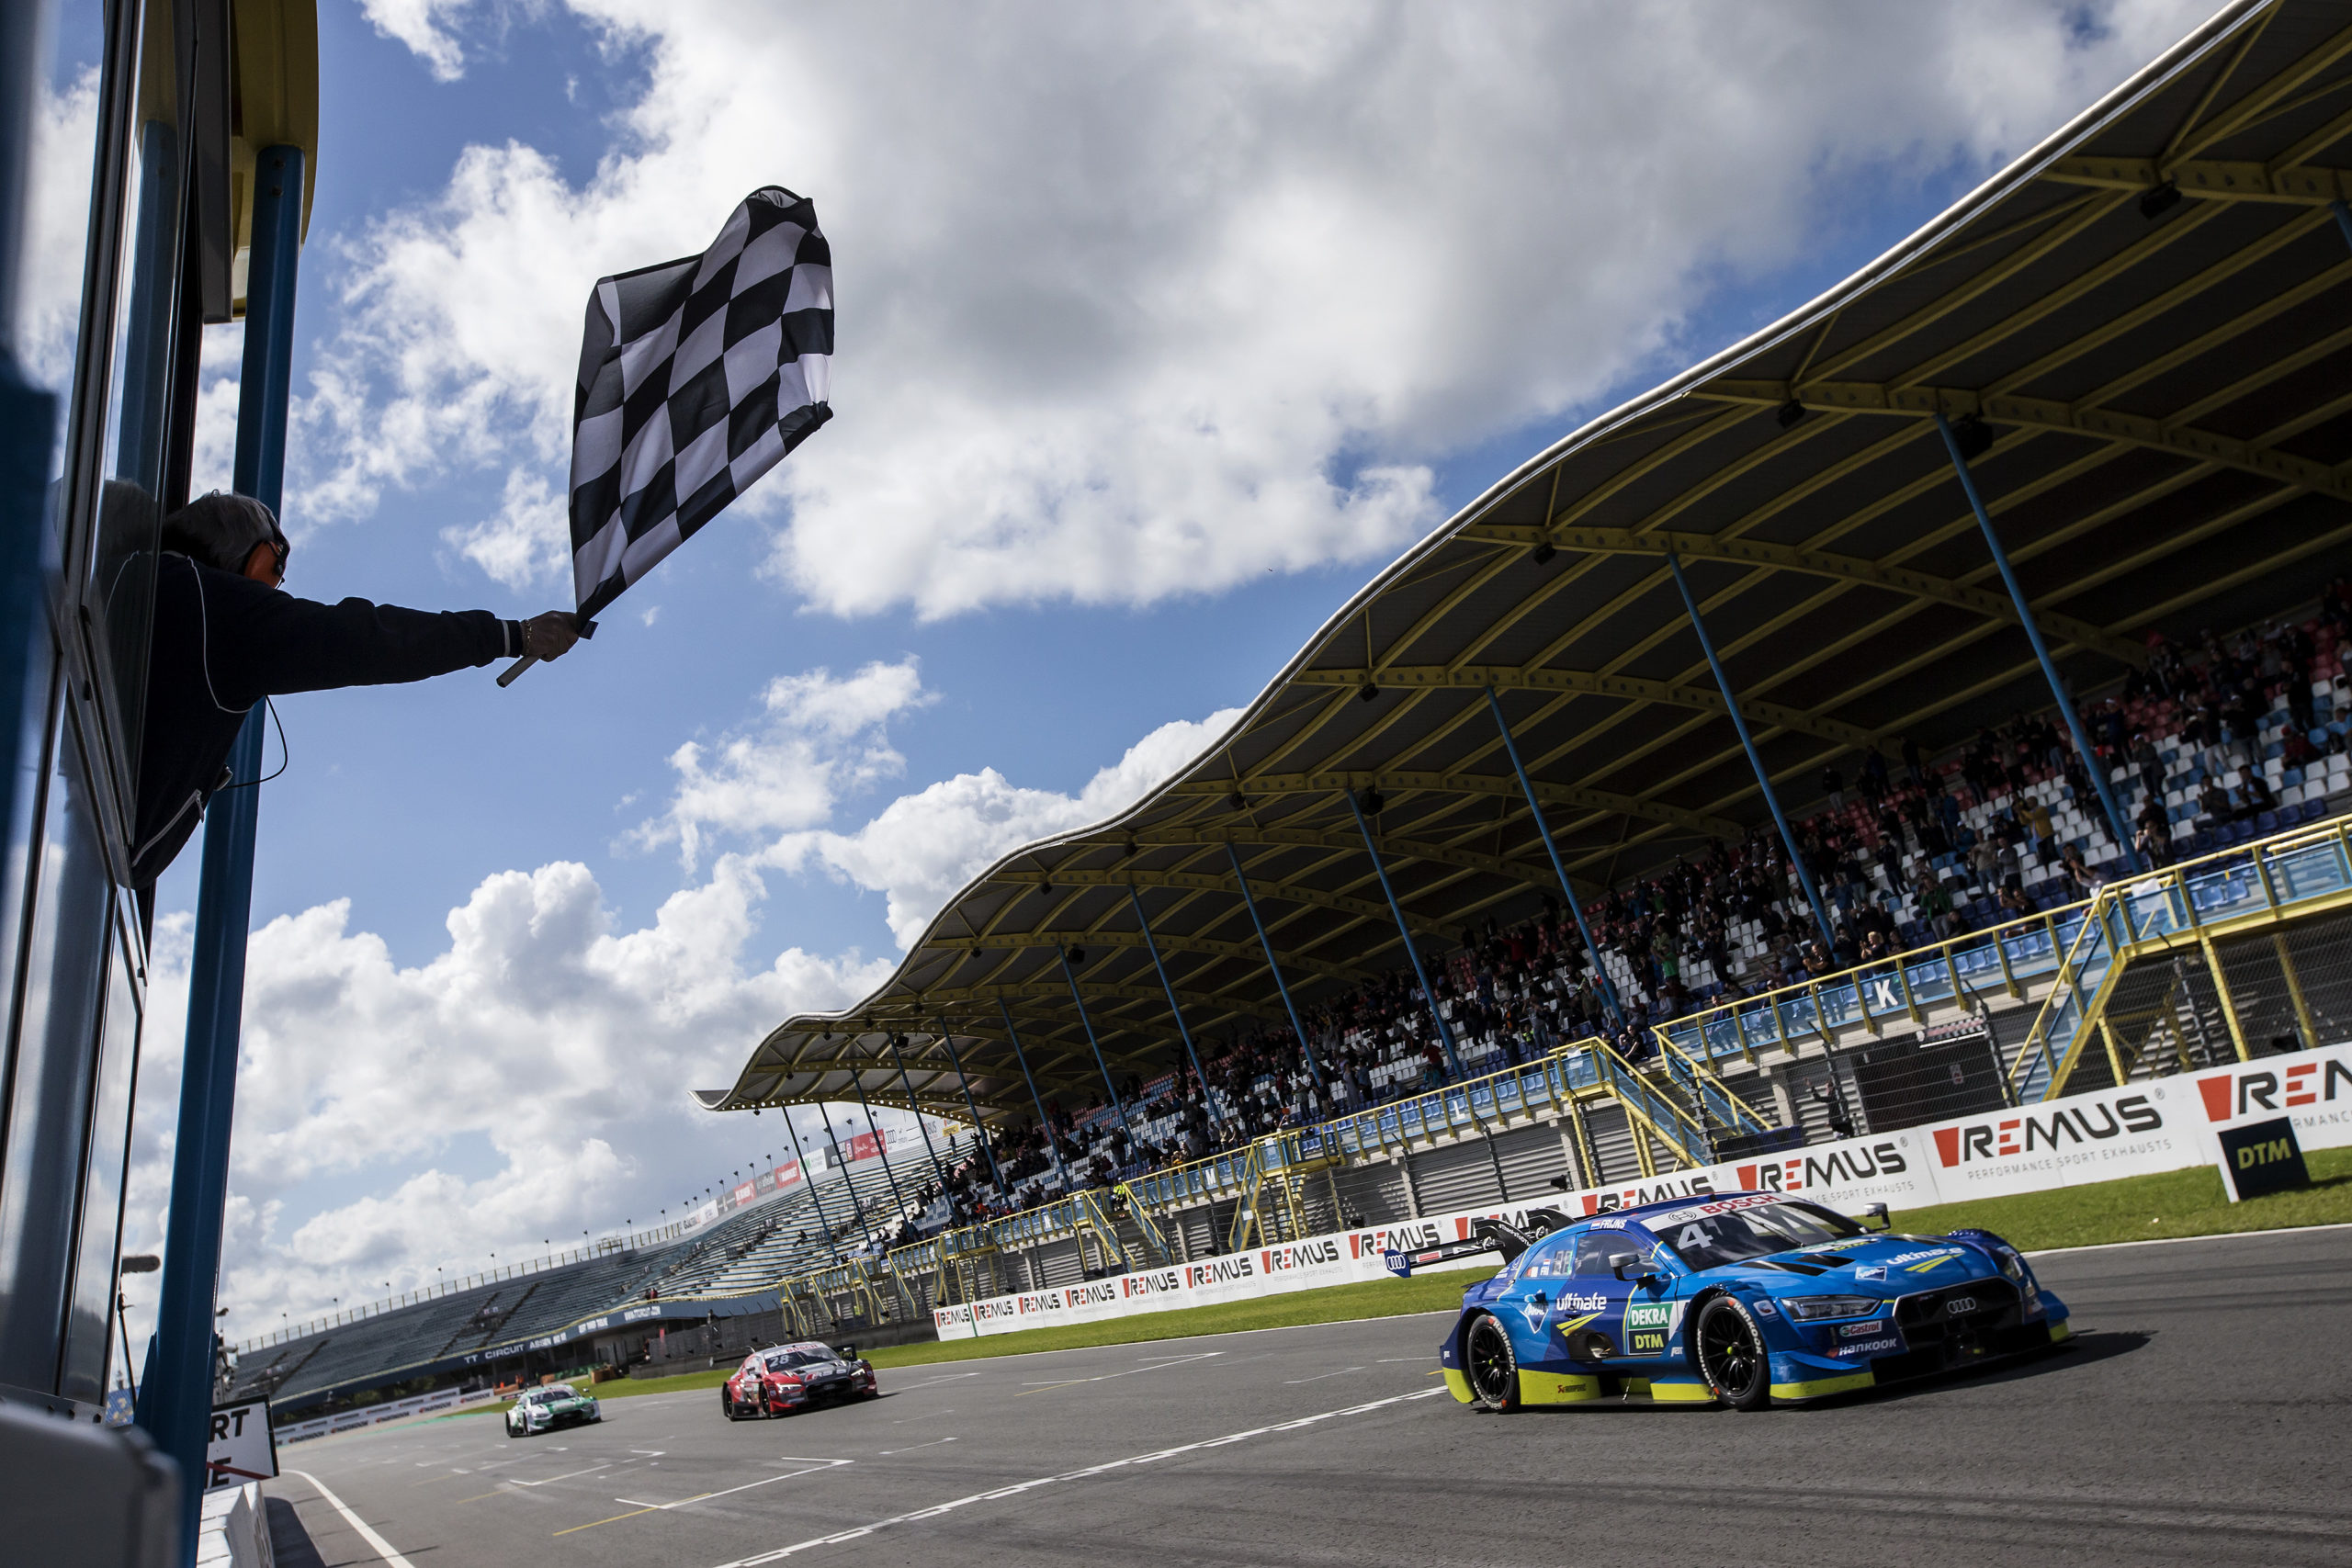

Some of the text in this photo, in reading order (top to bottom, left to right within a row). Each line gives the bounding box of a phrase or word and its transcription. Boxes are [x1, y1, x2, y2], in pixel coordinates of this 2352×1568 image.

[1874, 978, 1898, 1010] K
[1453, 1100, 1465, 1120] L
[1964, 1095, 2163, 1162] REMUS
[1968, 1138, 2172, 1181] PERFORMANCE SPORT EXHAUSTS
[2236, 1137, 2292, 1170] DTM
[1761, 1142, 1906, 1192] REMUS
[1827, 1189, 1860, 1202] SPORT
[1864, 1180, 1915, 1197] EXHAUSTS
[1700, 1194, 1782, 1214] BOSCH
[1600, 1219, 1627, 1230] FRIJNS
[1362, 1224, 1441, 1258] REMUS
[1677, 1223, 1713, 1250] 4
[1272, 1240, 1340, 1271] REMUS
[1885, 1247, 1966, 1265] ultimate
[1193, 1257, 1253, 1287] REMUS
[1071, 1283, 1115, 1306] REMUS
[1130, 1271, 1180, 1296] REMUS
[979, 1301, 1014, 1321] REMUS
[1024, 1292, 1061, 1314] REMUS
[1555, 1292, 1607, 1311] ultimate
[940, 1308, 970, 1326] REMUS
[1631, 1308, 1668, 1326] DEKRA
[1850, 1322, 1880, 1335] Castrol
[1634, 1333, 1664, 1349] DTM
[464, 1354, 478, 1363] TT
[485, 1344, 525, 1359] CIRCUIT
[769, 1354, 790, 1368] 28
